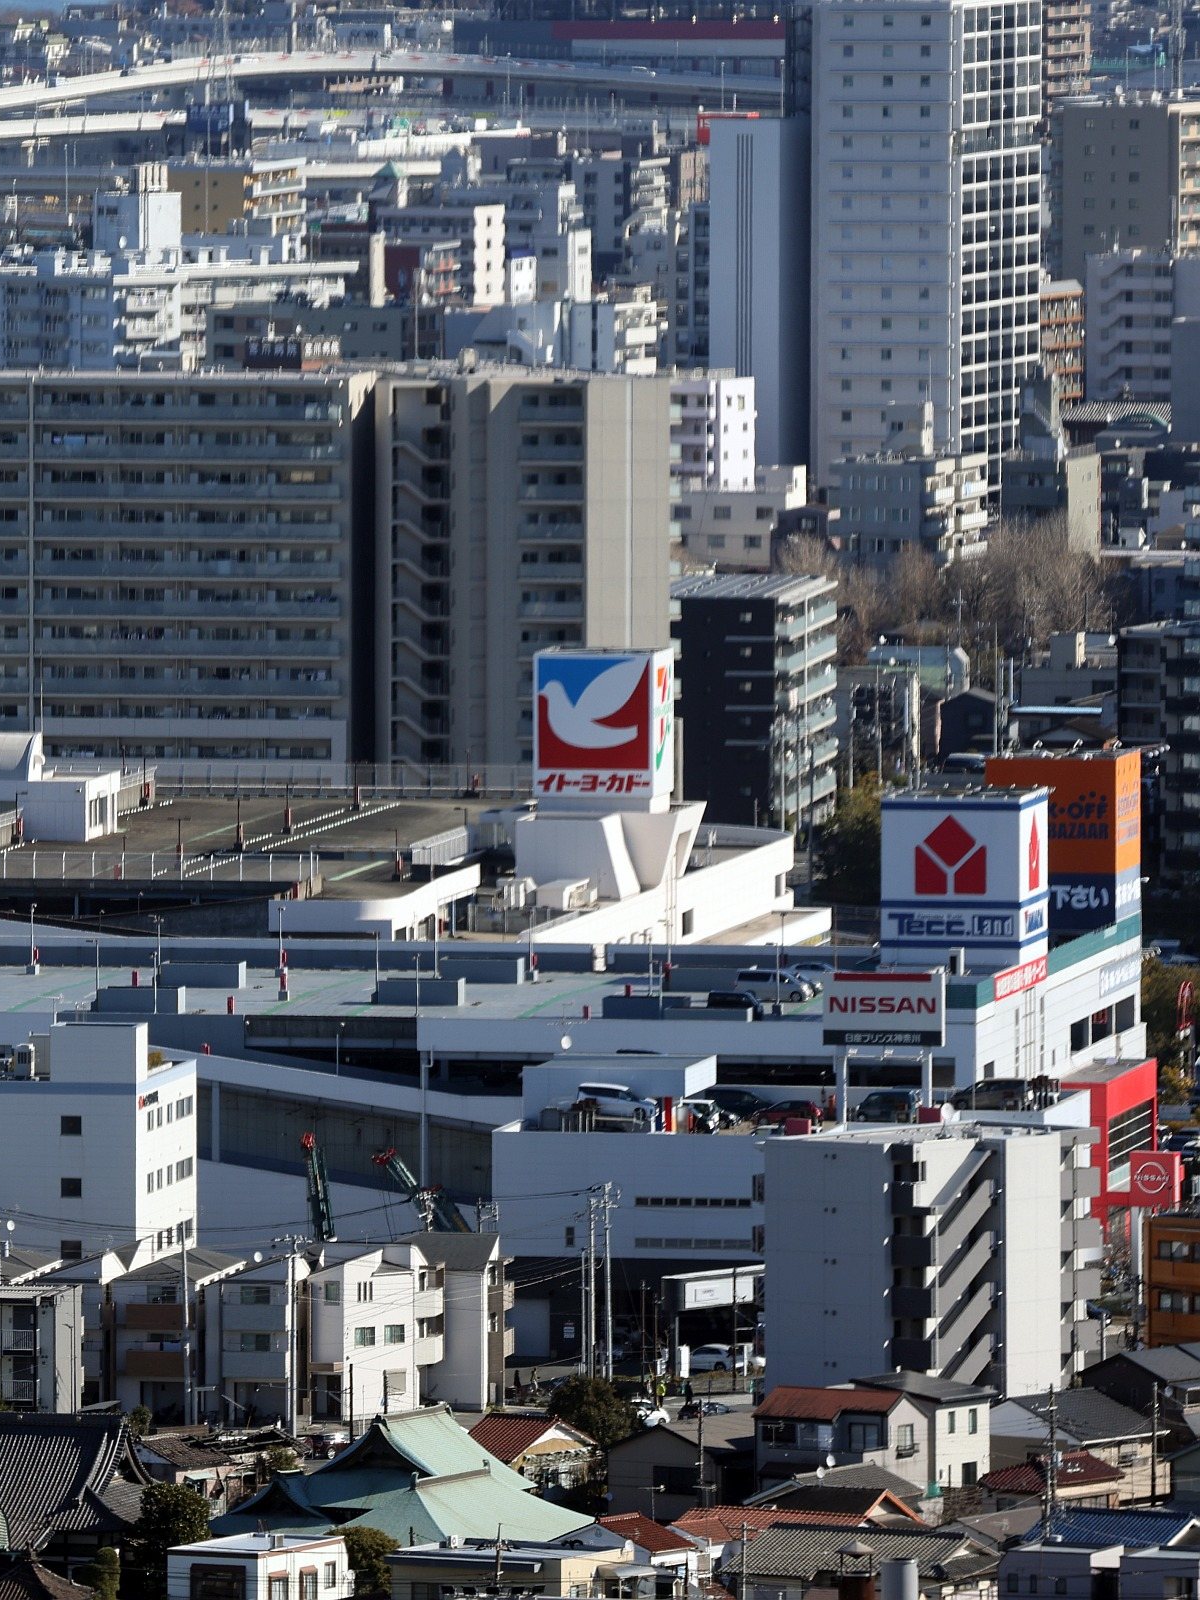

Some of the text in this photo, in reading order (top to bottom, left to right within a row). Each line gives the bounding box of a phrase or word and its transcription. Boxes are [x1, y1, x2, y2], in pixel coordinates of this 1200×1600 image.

[538, 773, 650, 792] イトーヨーカドー
[829, 996, 936, 1014] NISSAN
[845, 1033, 920, 1043] 日産プリンス神奈川
[1134, 1173, 1169, 1182] NISSAN
